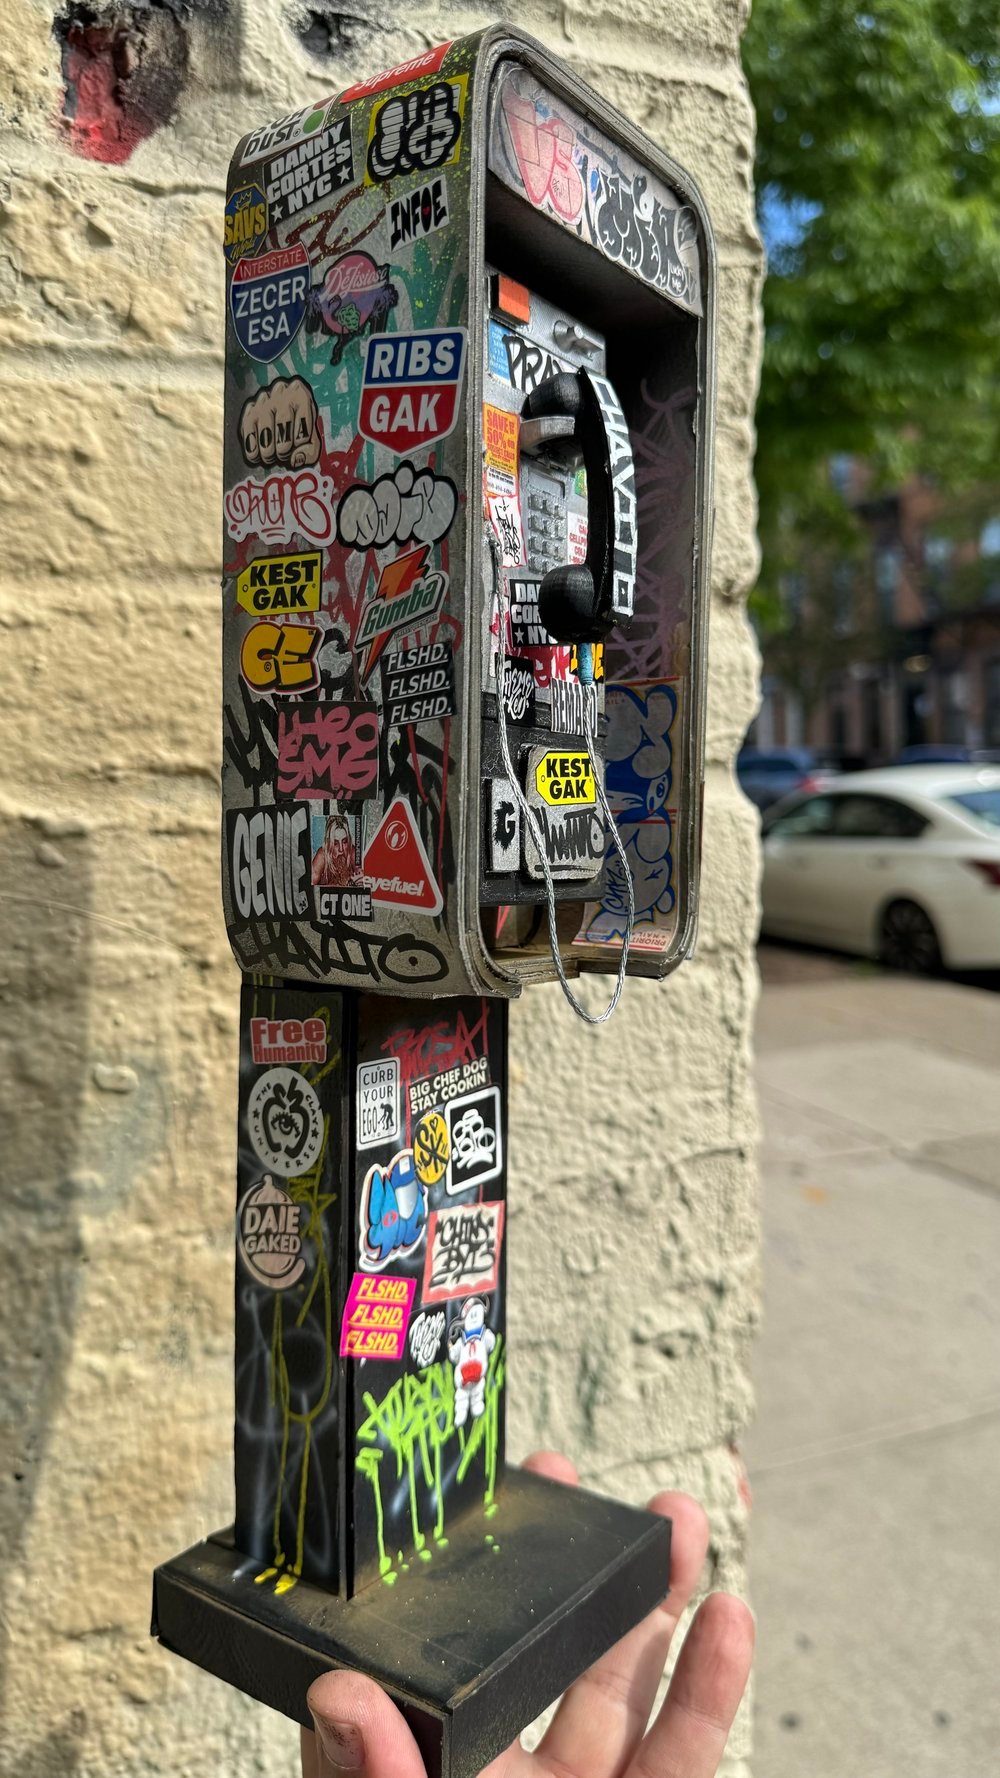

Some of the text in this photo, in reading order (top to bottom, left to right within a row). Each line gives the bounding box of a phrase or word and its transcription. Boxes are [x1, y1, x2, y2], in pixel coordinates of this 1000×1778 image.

[354, 50, 435, 91] Supreme
[270, 121, 346, 180] DANNY
[266, 140, 351, 204] CORTES
[287, 176, 332, 214] NYC
[240, 248, 302, 276] INTERSTATE
[236, 275, 306, 319] ZECER
[248, 312, 290, 346] ESA
[371, 339, 455, 379] RIBS
[369, 393, 442, 433] GAK
[245, 417, 309, 453] COMA
[250, 559, 319, 587] KEST
[252, 585, 308, 611] GAK
[362, 578, 439, 637] Gumba
[386, 643, 448, 672] FLSHD.
[388, 669, 450, 698] FLSHD.
[390, 696, 452, 725] FLSHD.
[546, 758, 592, 778] KEST
[549, 779, 588, 800] GAK
[233, 808, 309, 919] GENIE
[363, 875, 424, 897] eyefuel
[320, 892, 373, 917] CT ONE
[632, 937, 667, 946] PRIORIT
[252, 1019, 325, 1045] Free
[253, 1042, 326, 1063] Humanity
[363, 1070, 394, 1086] CURB
[409, 1057, 488, 1099] BIG CHEF DOG
[256, 1082, 319, 1125] THE CLAY
[363, 1085, 394, 1104] YOUR
[411, 1074, 486, 1115] STAY COOKIN
[362, 1106, 378, 1137] EGO
[254, 1125, 316, 1169] UNIVERSE
[244, 1234, 301, 1254] GAKED
[357, 1278, 409, 1299] FLSHD.
[351, 1304, 404, 1325] FLSHD.
[346, 1331, 398, 1351] FLSHD.
